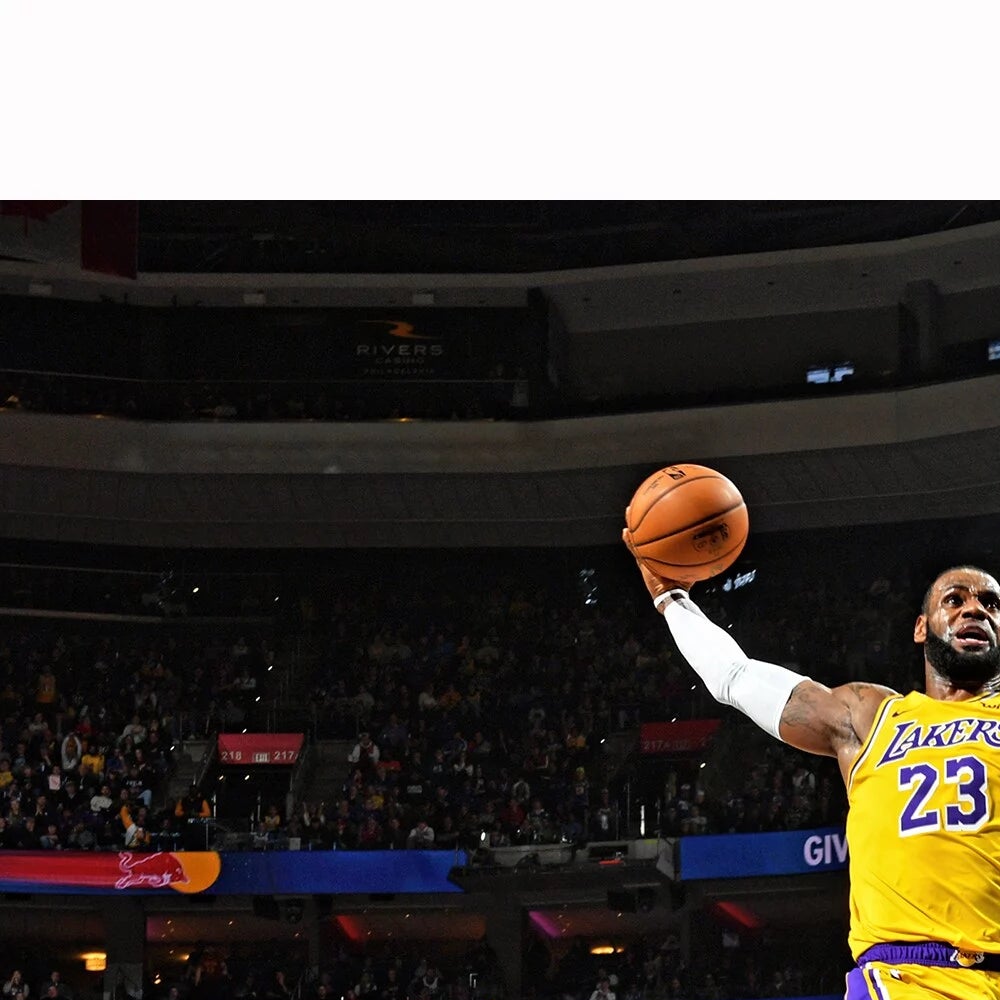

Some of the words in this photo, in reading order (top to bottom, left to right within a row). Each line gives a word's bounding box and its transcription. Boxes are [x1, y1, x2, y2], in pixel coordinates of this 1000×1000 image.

[356, 344, 443, 356] RIVERS
[221, 750, 242, 761] 218
[898, 755, 989, 837] 23
